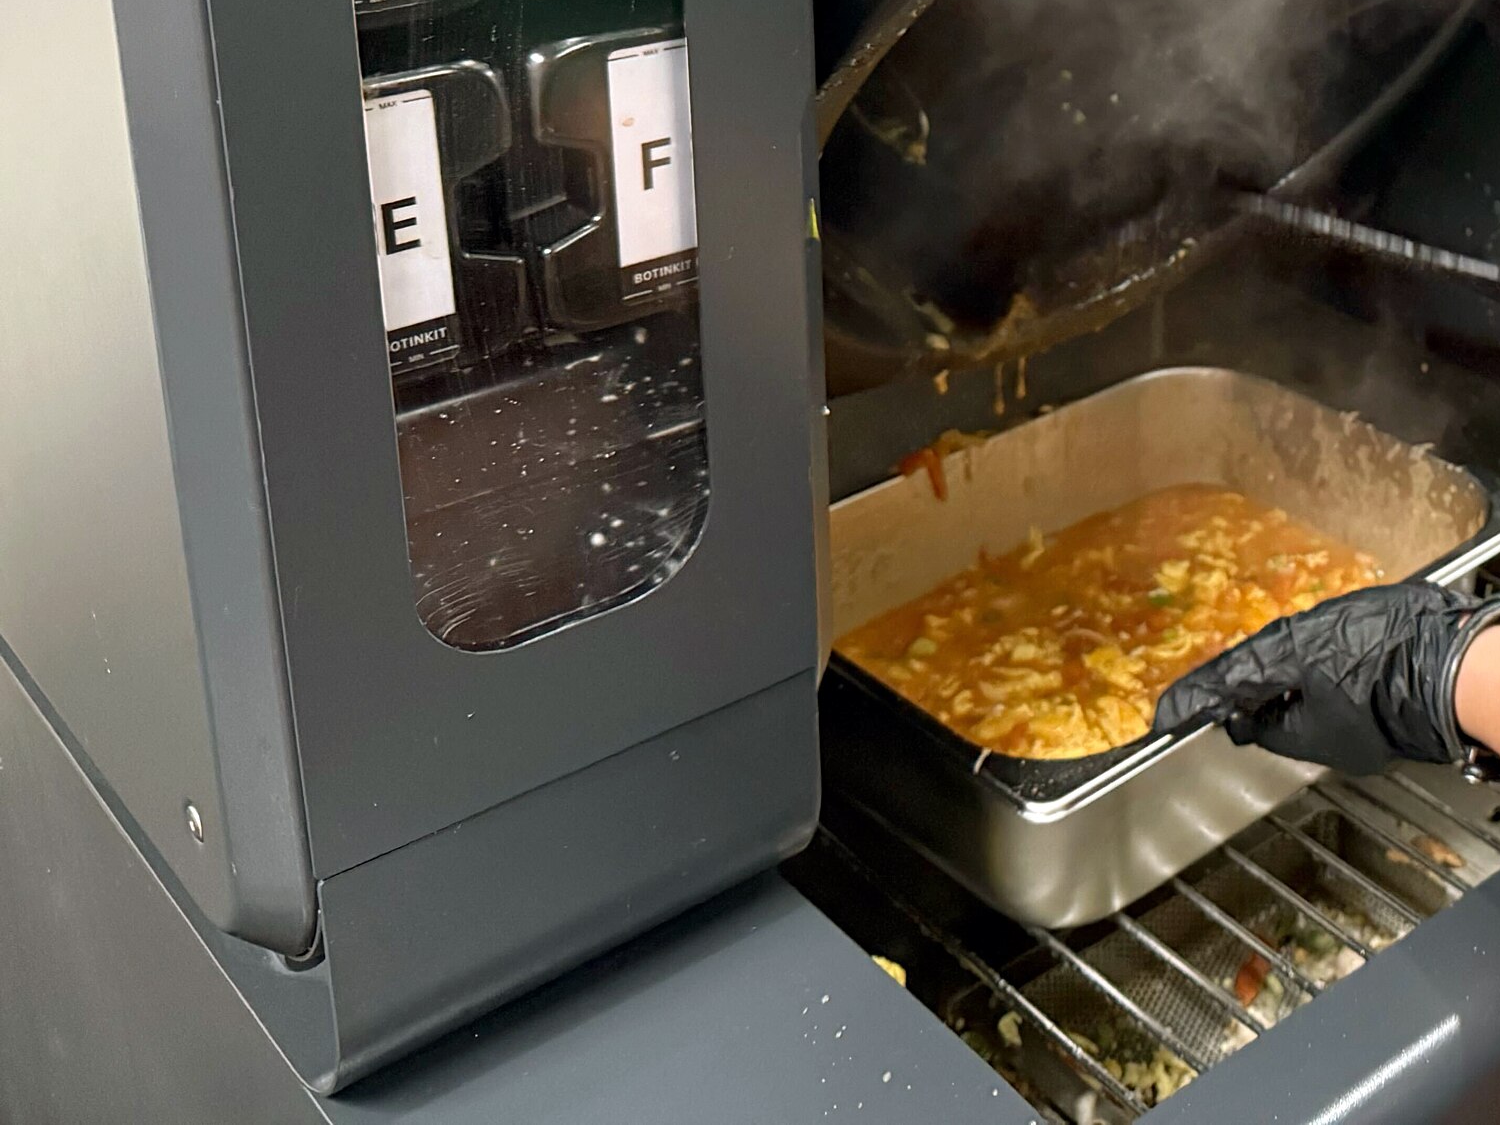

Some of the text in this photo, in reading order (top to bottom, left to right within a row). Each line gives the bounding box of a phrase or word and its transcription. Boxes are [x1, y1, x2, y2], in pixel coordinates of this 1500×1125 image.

[641, 137, 671, 190] F
[381, 196, 422, 255] E
[633, 259, 692, 285] BOTINKIT
